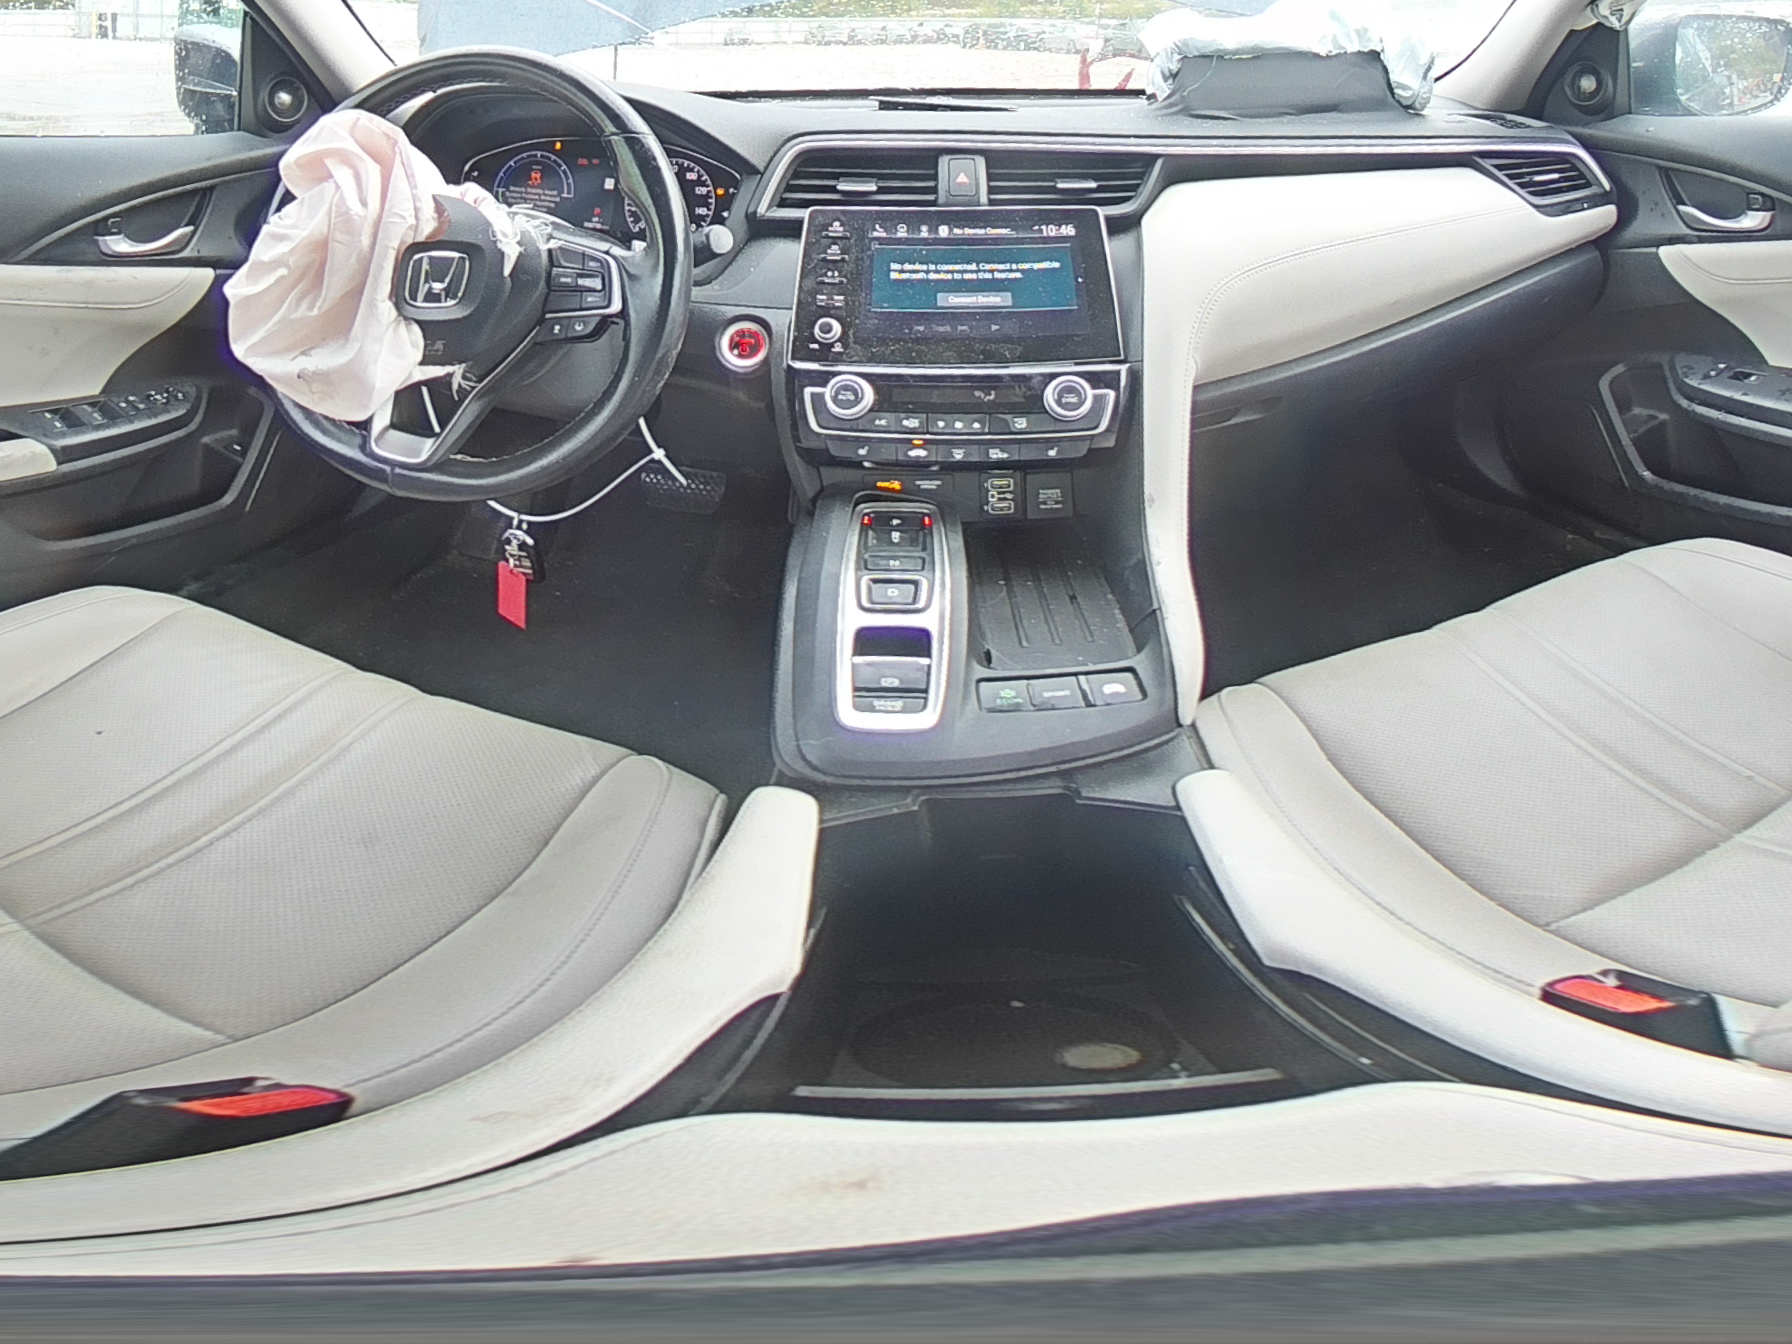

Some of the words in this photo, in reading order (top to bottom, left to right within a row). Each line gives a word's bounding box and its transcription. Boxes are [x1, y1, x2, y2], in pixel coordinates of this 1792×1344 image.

[695, 187, 707, 195] 120
[1040, 224, 1076, 236] 10:46
[890, 262, 902, 270] No
[903, 262, 927, 270] device
